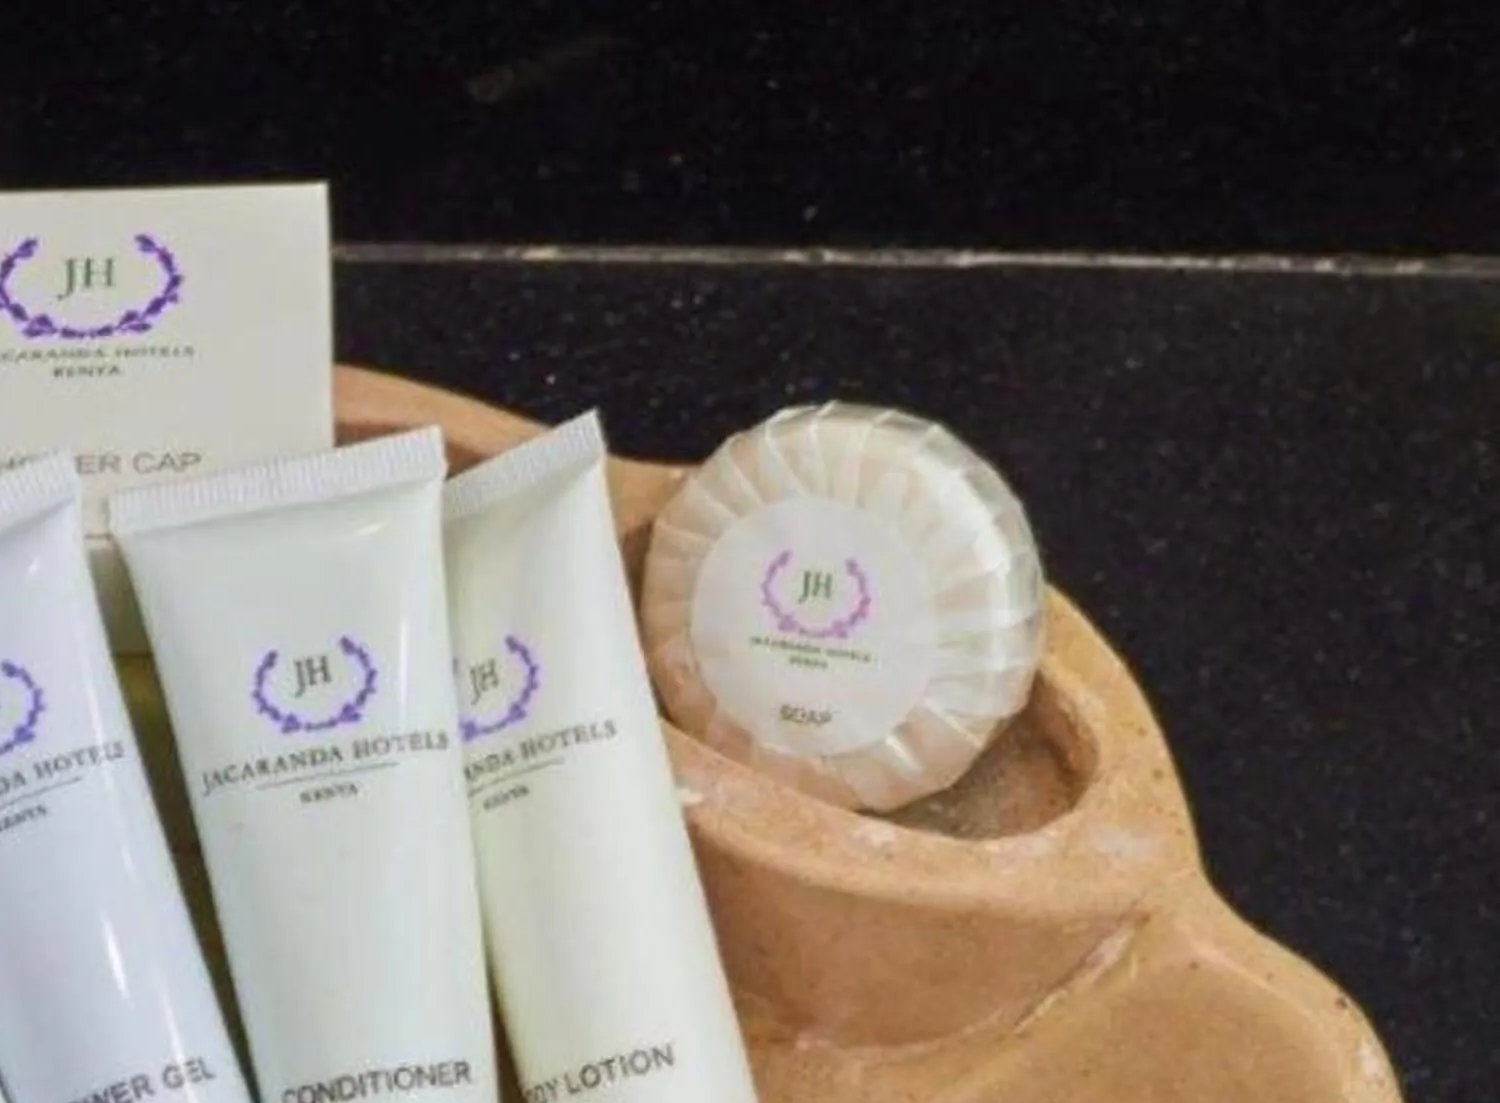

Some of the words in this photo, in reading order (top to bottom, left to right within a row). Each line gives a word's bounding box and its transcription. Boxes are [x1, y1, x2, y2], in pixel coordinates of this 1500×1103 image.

[56, 256, 117, 300] JH
[132, 451, 203, 474] CAP
[797, 569, 833, 604] JH
[292, 654, 332, 699] JH
[470, 657, 498, 706] JH
[520, 720, 617, 759] HOTELS
[202, 745, 344, 798] JACARANDA
[351, 730, 449, 760] HOTELS
[161, 1056, 217, 1089] GEL
[563, 1044, 676, 1095] LOTION
